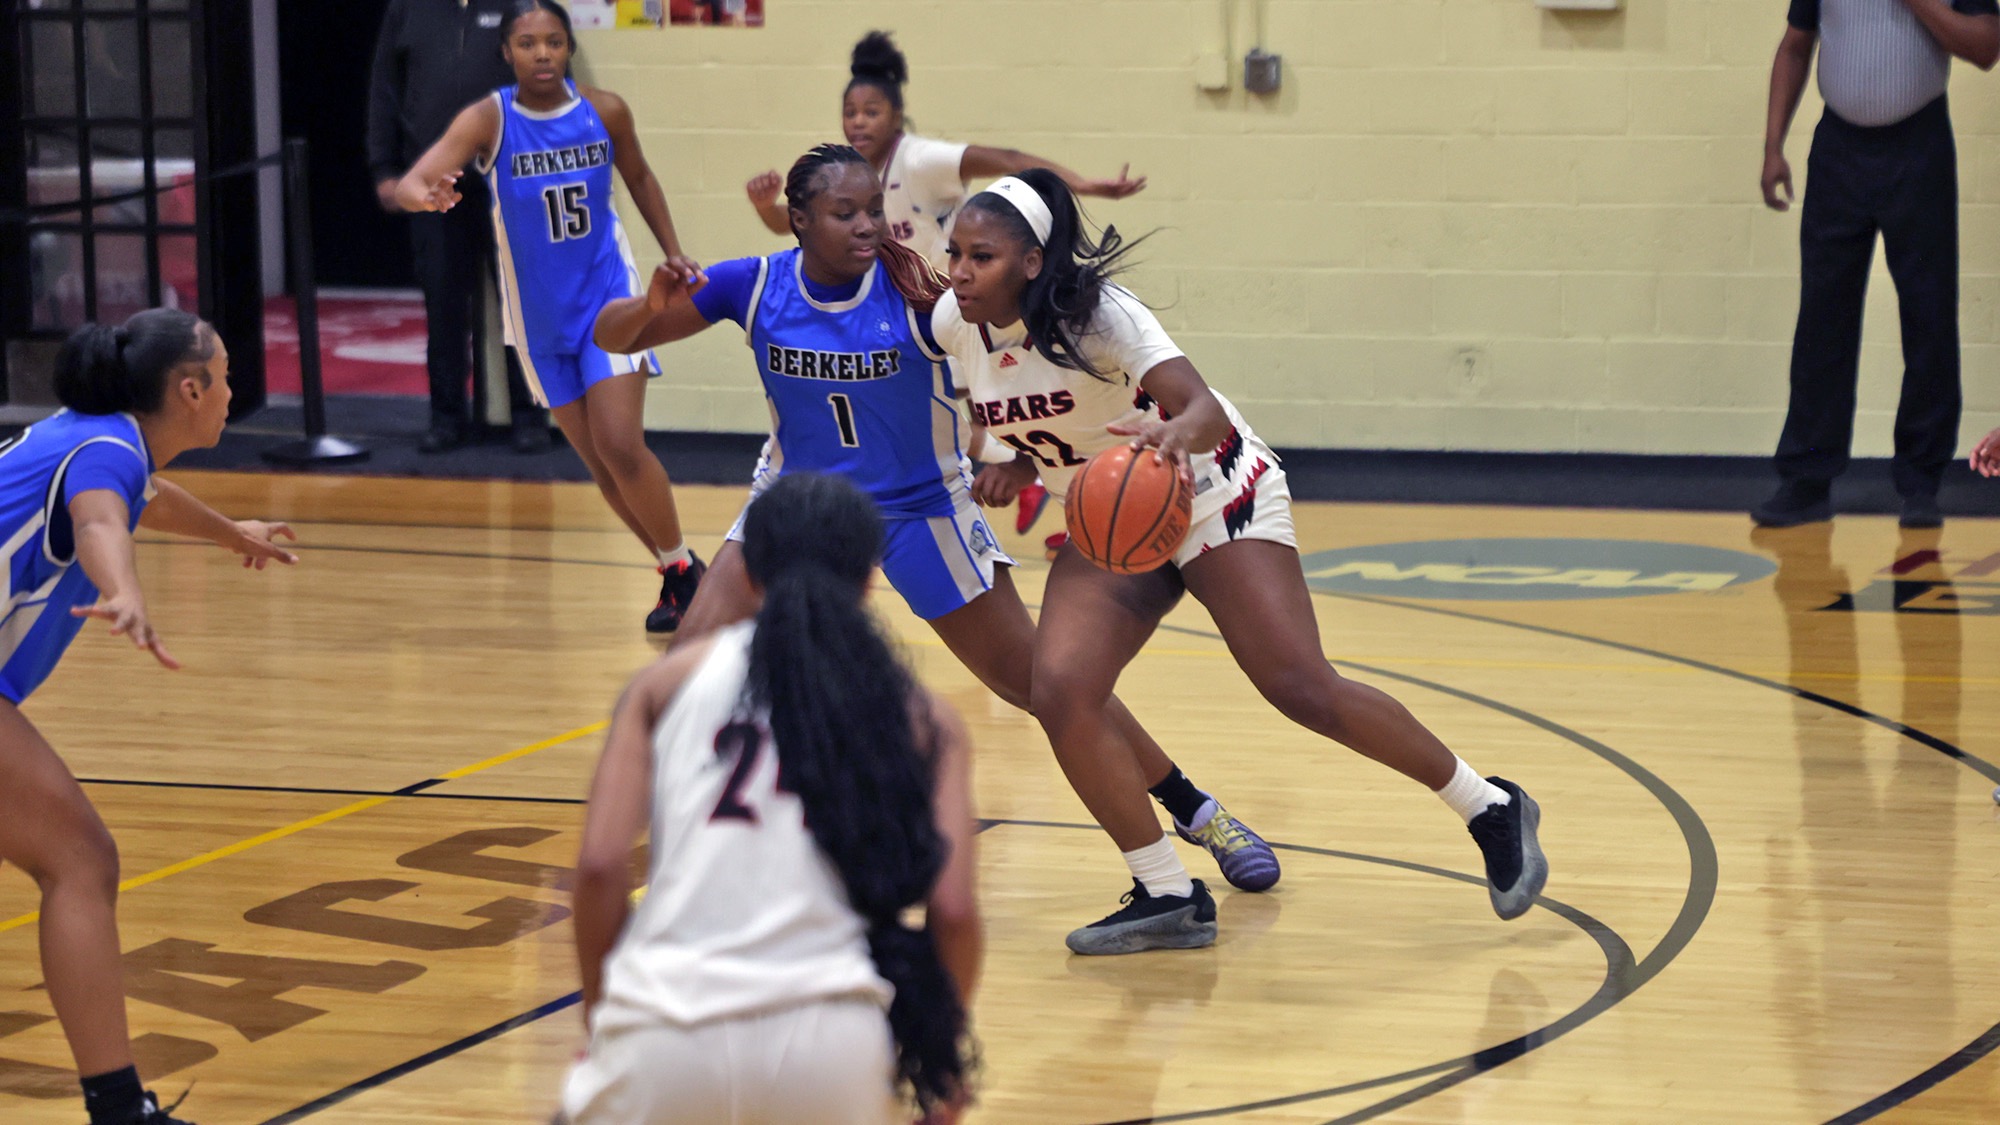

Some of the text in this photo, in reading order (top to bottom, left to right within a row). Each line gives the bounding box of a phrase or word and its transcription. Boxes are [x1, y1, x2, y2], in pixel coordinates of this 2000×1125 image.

[542, 182, 591, 242] 15
[767, 343, 901, 382] BERKELEY
[827, 393, 860, 448] 1
[975, 389, 1076, 428] BEARS
[1000, 430, 1088, 468] 12
[1304, 561, 1738, 590] NCAA
